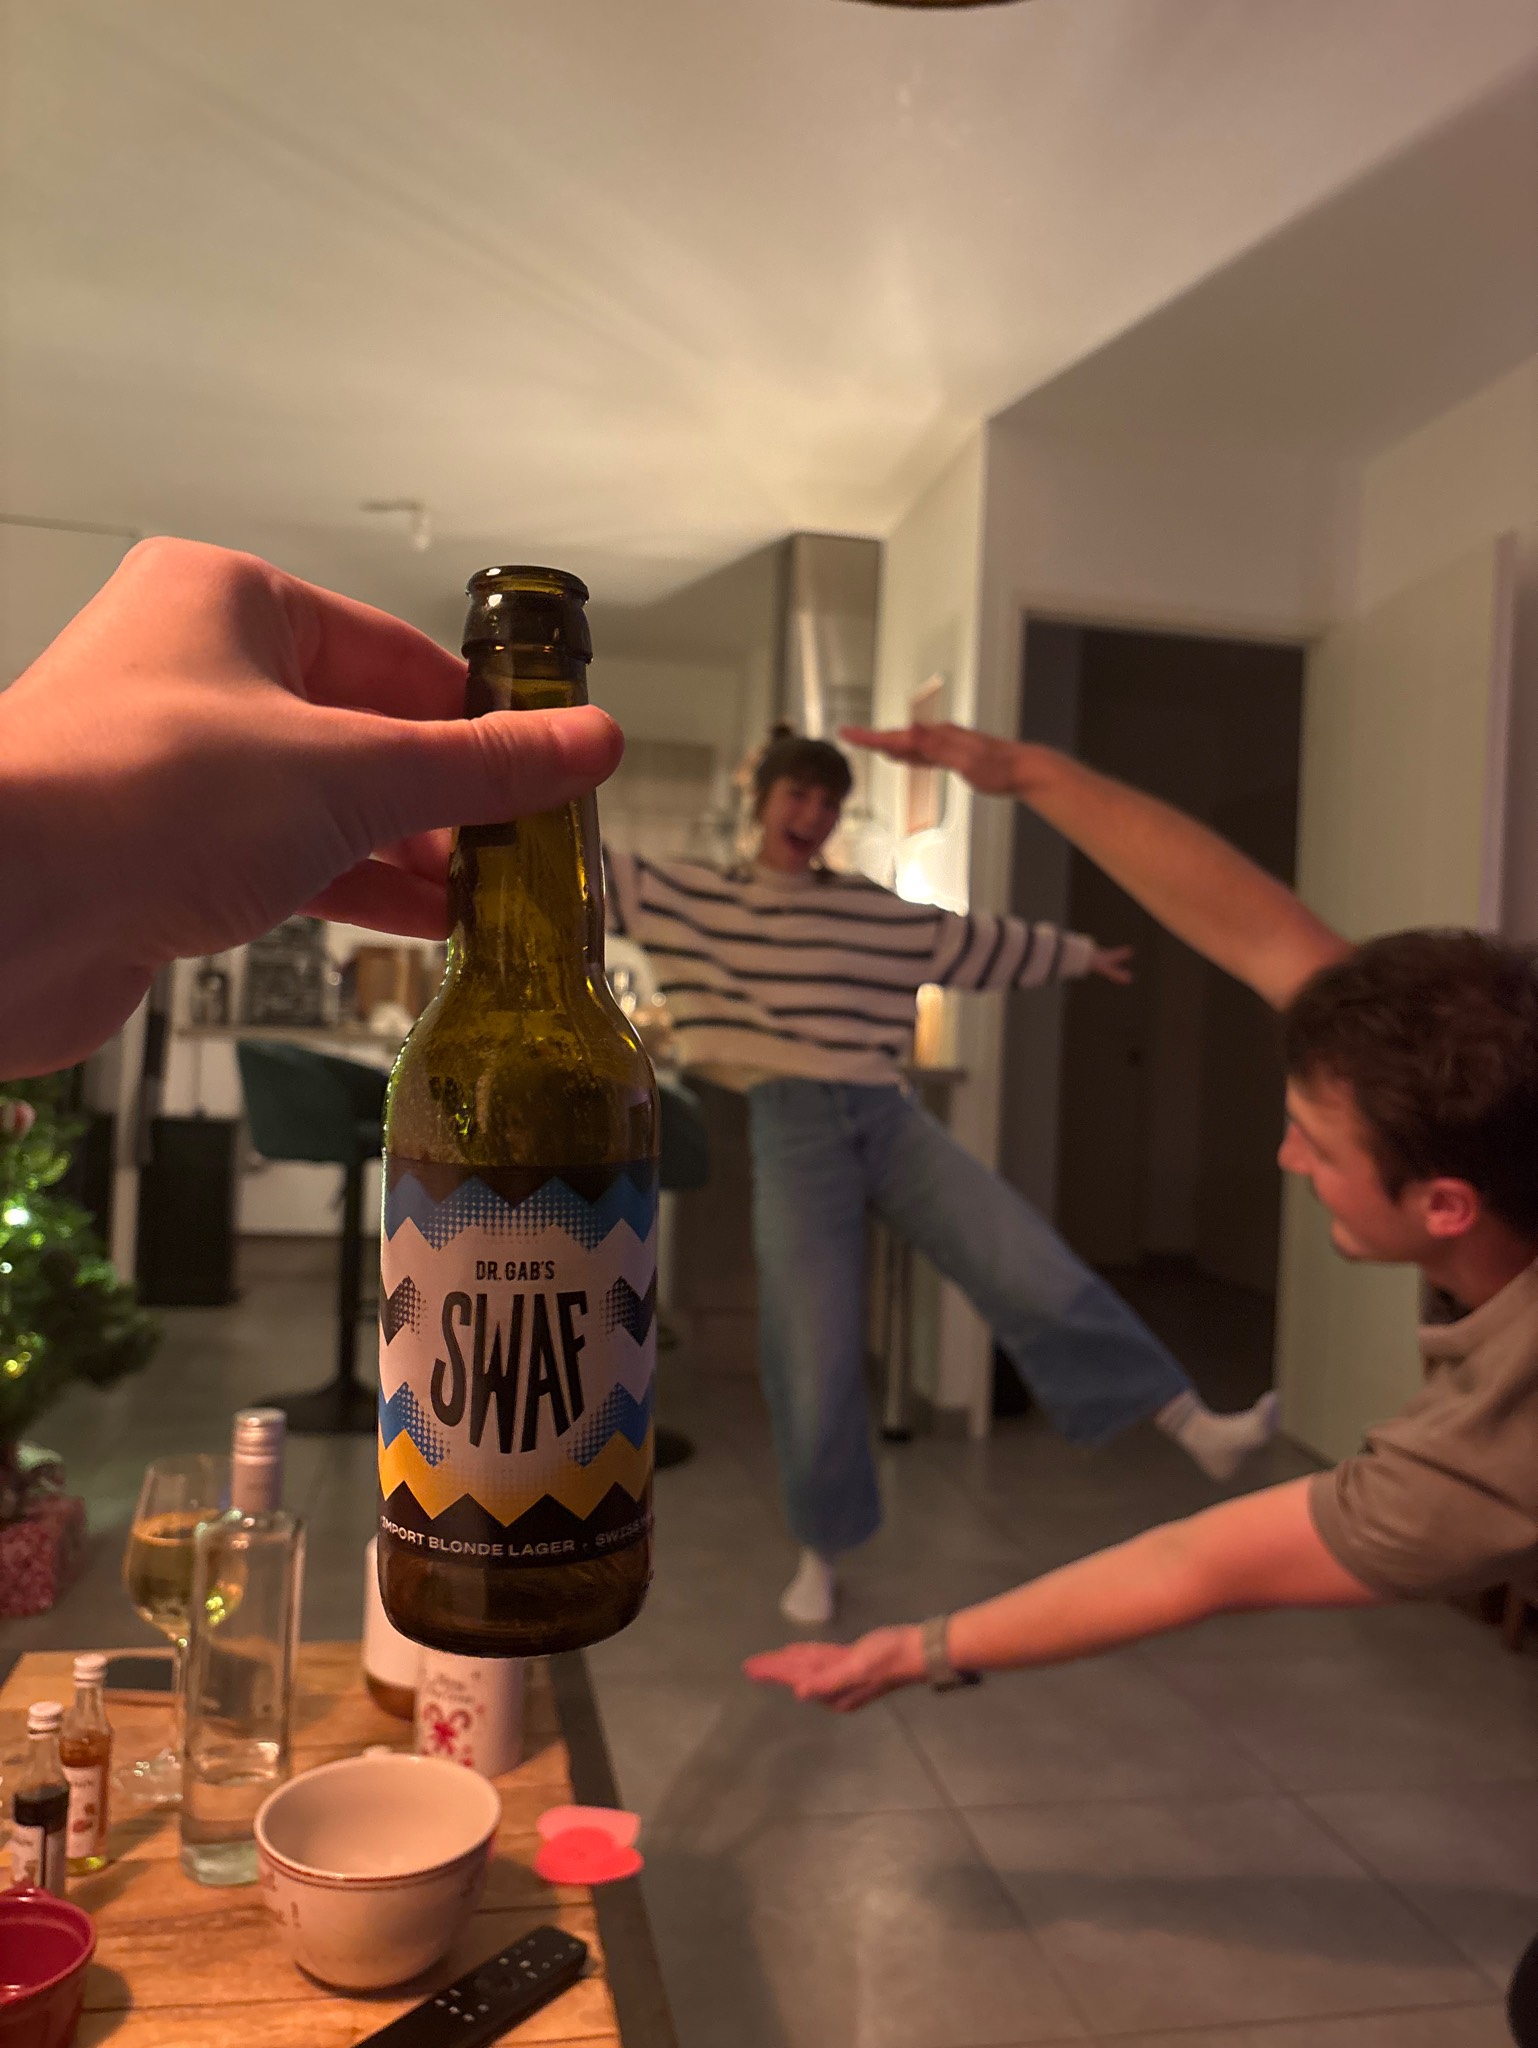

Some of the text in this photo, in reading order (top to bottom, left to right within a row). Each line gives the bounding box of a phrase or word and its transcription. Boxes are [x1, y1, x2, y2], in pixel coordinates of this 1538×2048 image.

[505, 1260, 555, 1281] GAB'S
[430, 1290, 588, 1454] SWAF
[381, 1515, 425, 1546] IMPORT
[428, 1536, 504, 1556] BLONDE
[508, 1539, 576, 1556] LAGER
